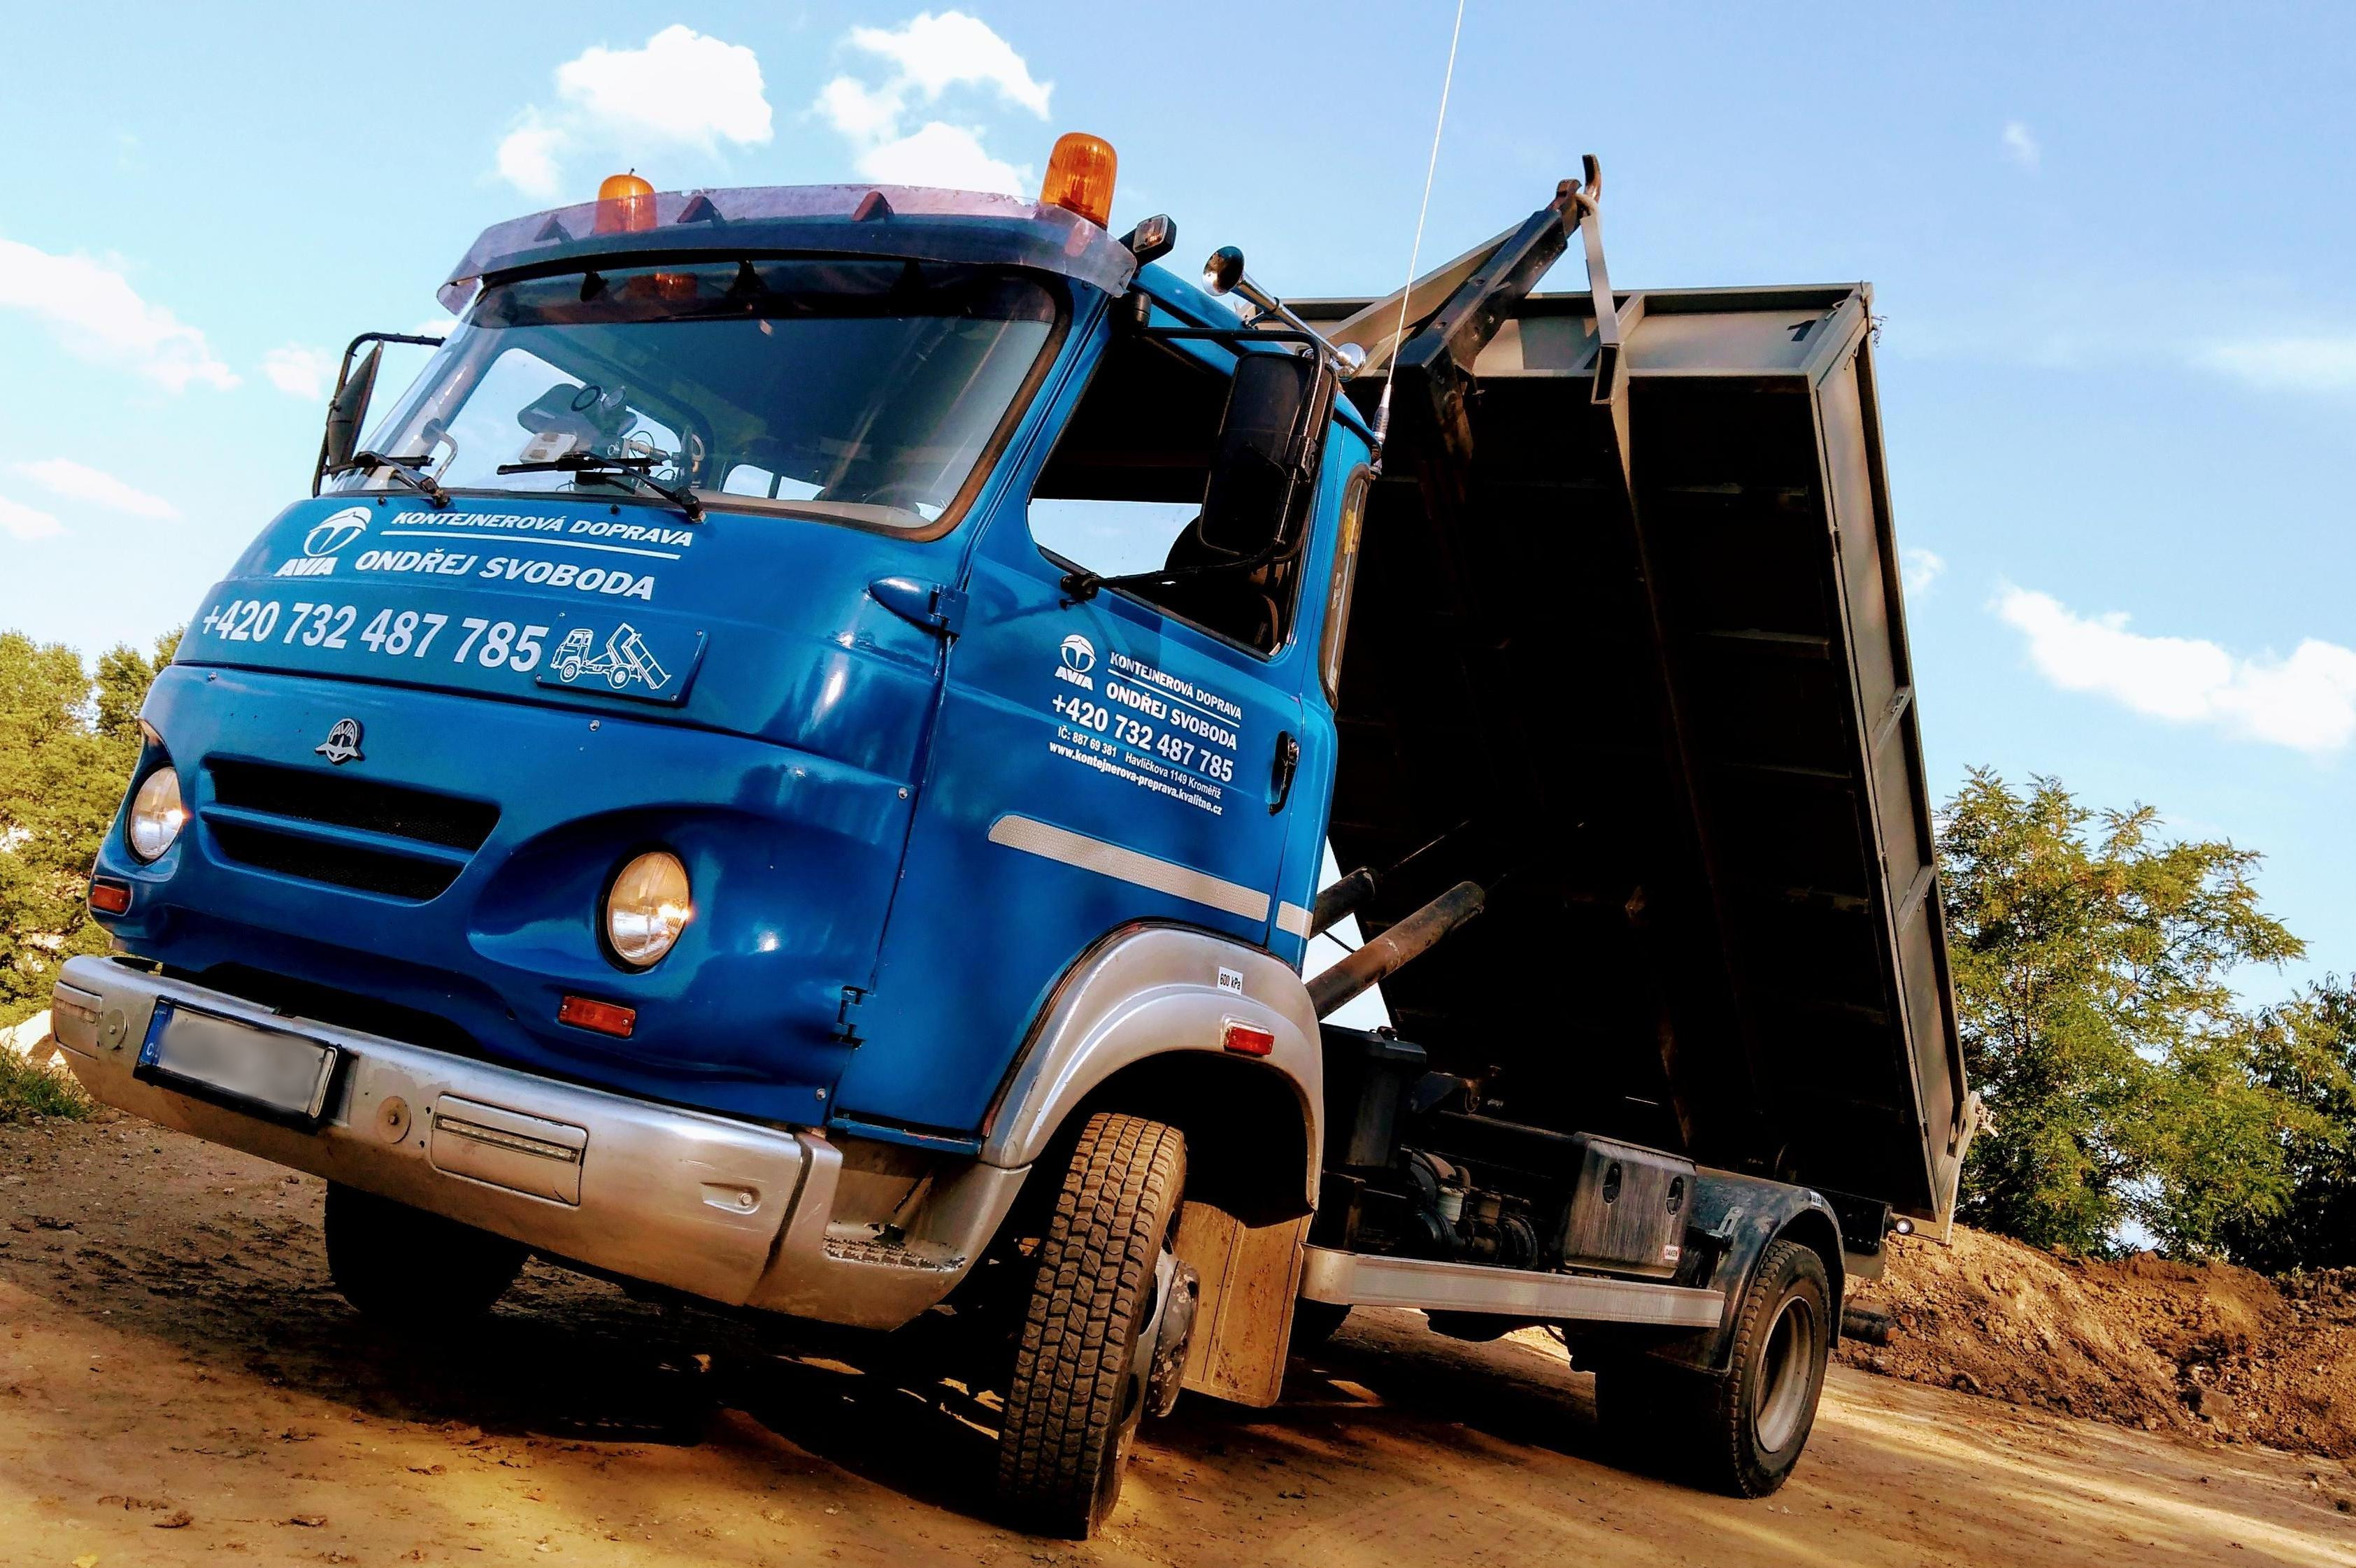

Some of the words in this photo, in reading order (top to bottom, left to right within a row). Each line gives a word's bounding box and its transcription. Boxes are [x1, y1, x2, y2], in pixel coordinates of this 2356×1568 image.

[391, 512, 567, 532] KONTEJNEROVÁ
[568, 520, 693, 546] DOPRAVA
[273, 557, 338, 576] AVIA
[355, 548, 479, 575] ONDŘEJ
[479, 557, 655, 601] SVOBODA
[202, 599, 280, 642] +420
[283, 602, 357, 649] 732
[359, 608, 449, 657] 487
[453, 617, 550, 672] 785
[1054, 666, 1094, 691] AVIA
[1110, 651, 1194, 698] KONTEJNEROVÁ
[1195, 688, 1242, 720] DOPRAVA
[329, 722, 355, 746] AVIA
[1052, 694, 1108, 732] +420
[1113, 714, 1153, 750] 732
[1157, 733, 1195, 766] 487
[1199, 749, 1234, 783] 785
[1106, 682, 1168, 720] ONDŘEJ
[1170, 708, 1238, 750] SVOBODA
[1049, 741, 1223, 816] www.kontejnerova-preprava.kvalitne.cz
[1057, 725, 1071, 741] IČ:
[1072, 732, 1087, 746] 887
[1090, 739, 1101, 752] 69
[1101, 743, 1118, 757] 381
[1125, 751, 1169, 778] Havlíčkova
[1170, 769, 1188, 785] 1149
[1188, 777, 1222, 799] Kroměříž
[1231, 976, 1241, 990] kPa
